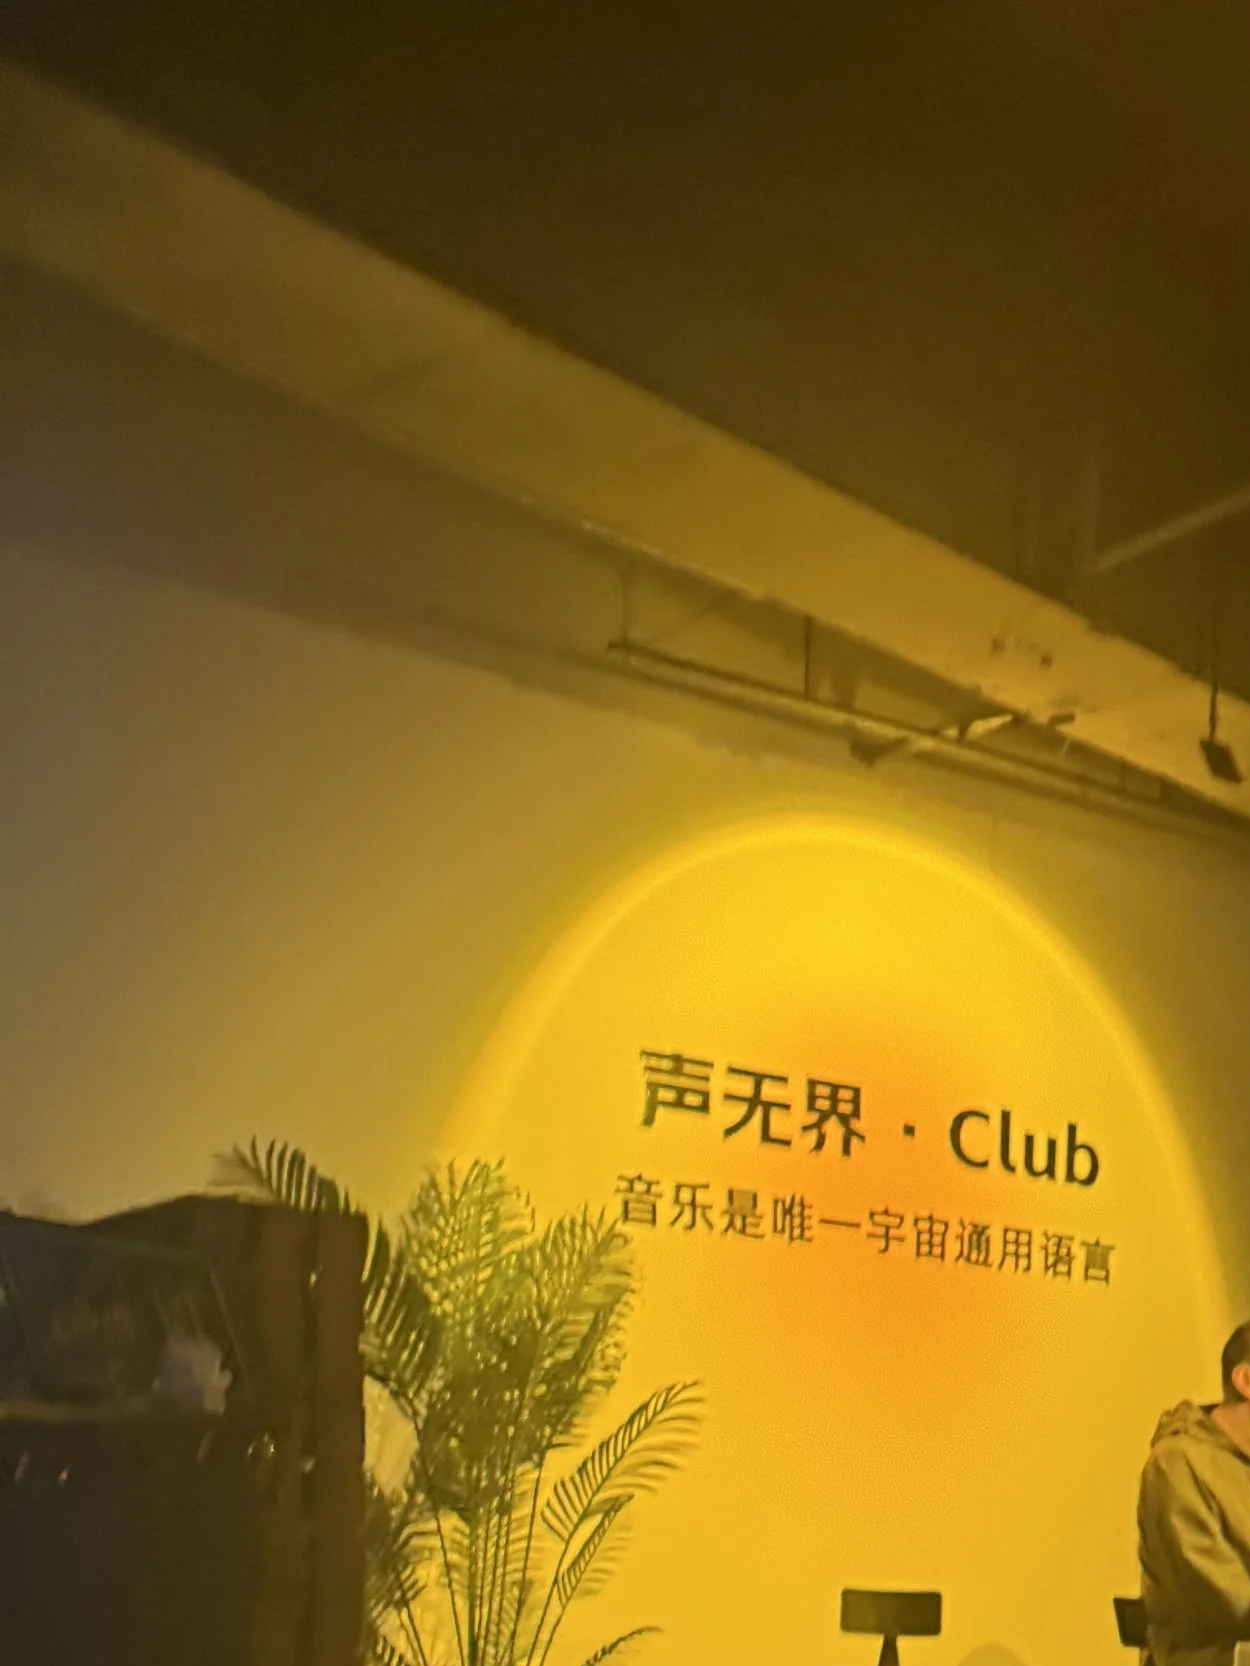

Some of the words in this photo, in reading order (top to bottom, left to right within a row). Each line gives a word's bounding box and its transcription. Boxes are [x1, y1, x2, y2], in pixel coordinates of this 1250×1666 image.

[640, 1048, 867, 1158] 声无界
[949, 1108, 1101, 1187] Club
[614, 1172, 1117, 1285] 音乐是唯一宇宙通用语言
